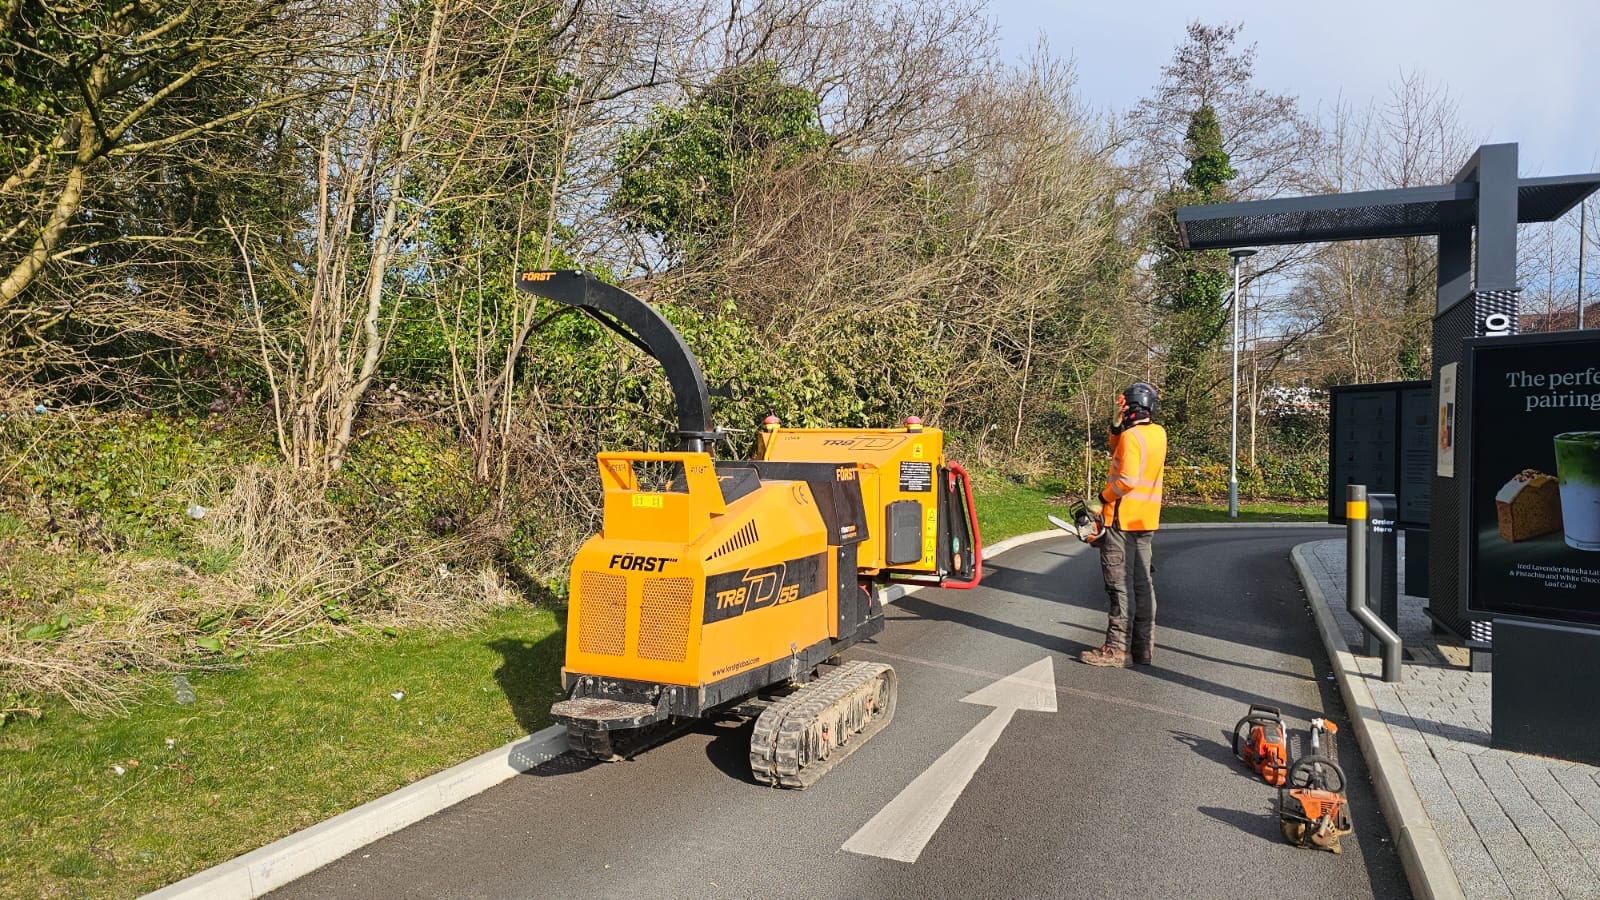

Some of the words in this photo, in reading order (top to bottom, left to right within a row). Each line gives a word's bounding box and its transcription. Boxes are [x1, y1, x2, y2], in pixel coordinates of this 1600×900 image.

[1506, 370, 1545, 388] The
[1525, 390, 1600, 412] pairing
[1371, 518, 1394, 526] Order
[1532, 565, 1562, 573] Lavender
[1563, 567, 1588, 575] Matcha
[1515, 570, 1545, 579] Pistachio
[1559, 574, 1580, 582] White
[1560, 581, 1577, 589] Cake
